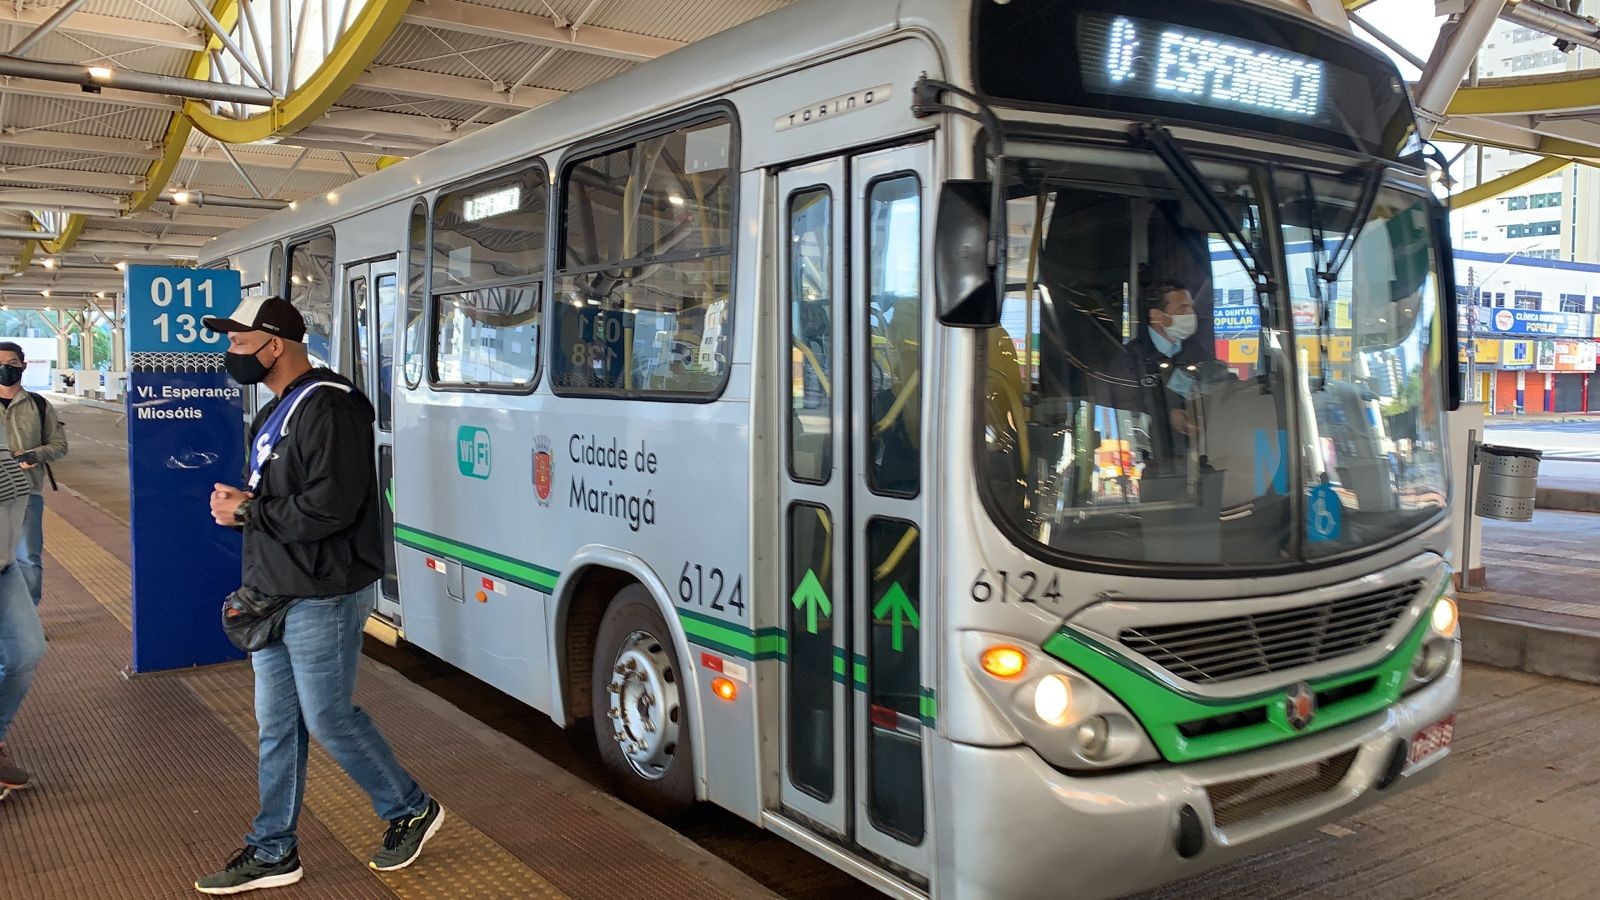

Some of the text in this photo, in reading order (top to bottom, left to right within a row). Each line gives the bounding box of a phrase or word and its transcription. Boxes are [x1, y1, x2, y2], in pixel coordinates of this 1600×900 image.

[150, 277, 213, 308] 011
[1214, 317, 1253, 325] OPULAR
[162, 385, 240, 400] Esperança
[137, 407, 203, 419] Miosótis
[568, 433, 658, 475] Cidade de
[568, 474, 656, 532] Maringá
[678, 560, 745, 617] 6124
[971, 568, 1062, 604] 6124
